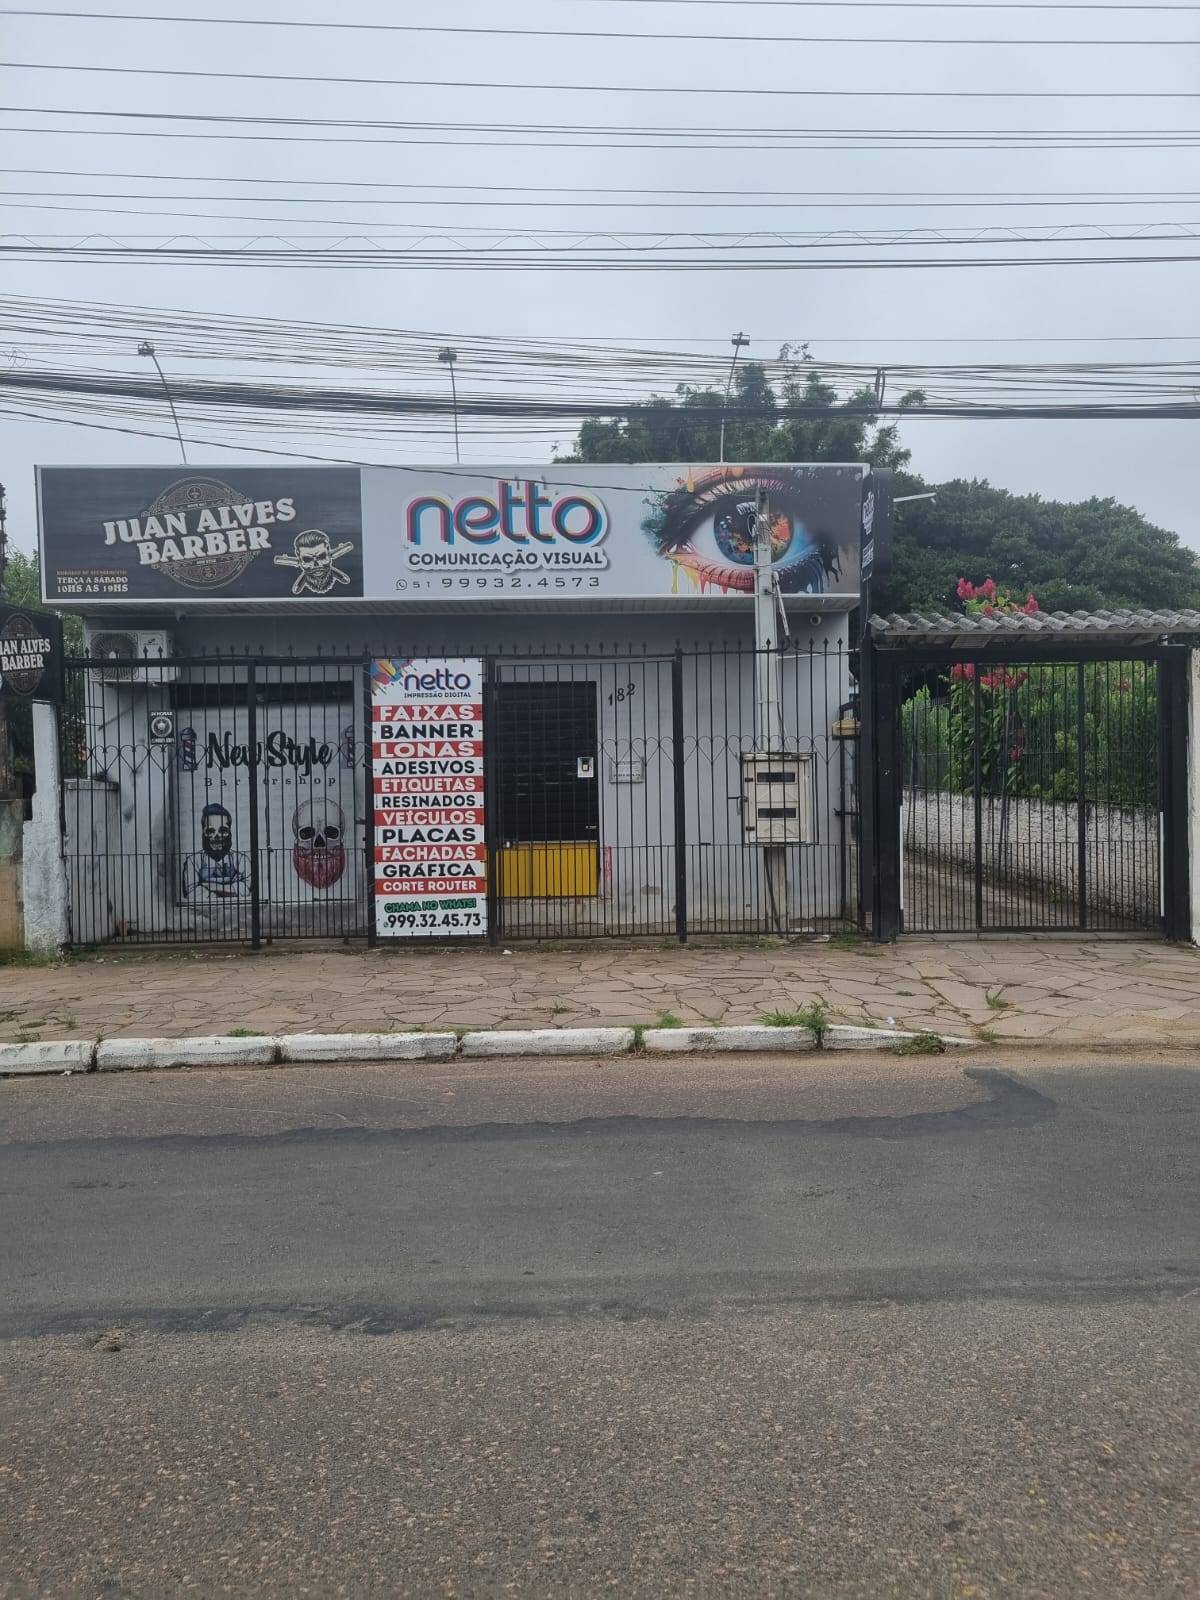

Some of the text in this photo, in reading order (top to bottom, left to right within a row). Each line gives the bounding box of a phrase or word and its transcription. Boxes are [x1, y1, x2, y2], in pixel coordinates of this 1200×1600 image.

[406, 480, 603, 545] netto
[103, 497, 296, 545] JUAN ALVES
[137, 527, 272, 565] BARBER
[408, 549, 602, 568] COMUNICAÇÃO VISUAL
[412, 576, 600, 589] 51 99932.4573
[20, 638, 51, 653] ALVES
[2, 654, 44, 671] BARBER
[404, 668, 471, 690] netto
[608, 682, 636, 706] 182
[380, 705, 475, 721] FAIXAS
[380, 723, 474, 739] BANNER
[206, 731, 333, 776] New Style
[380, 741, 475, 757] LONAS
[381, 760, 475, 775] ADESIVOS
[381, 777, 476, 792] ETIQUETAS
[382, 795, 476, 808] RESINADOS
[382, 828, 476, 843] PLACAS
[382, 846, 477, 860] FACHADAS
[382, 863, 476, 877] GRÁFICA
[382, 880, 477, 892] CORTE ROUTER
[384, 898, 476, 913] CHAMA NO WHATS!
[387, 913, 481, 928] 999.32.45.73
